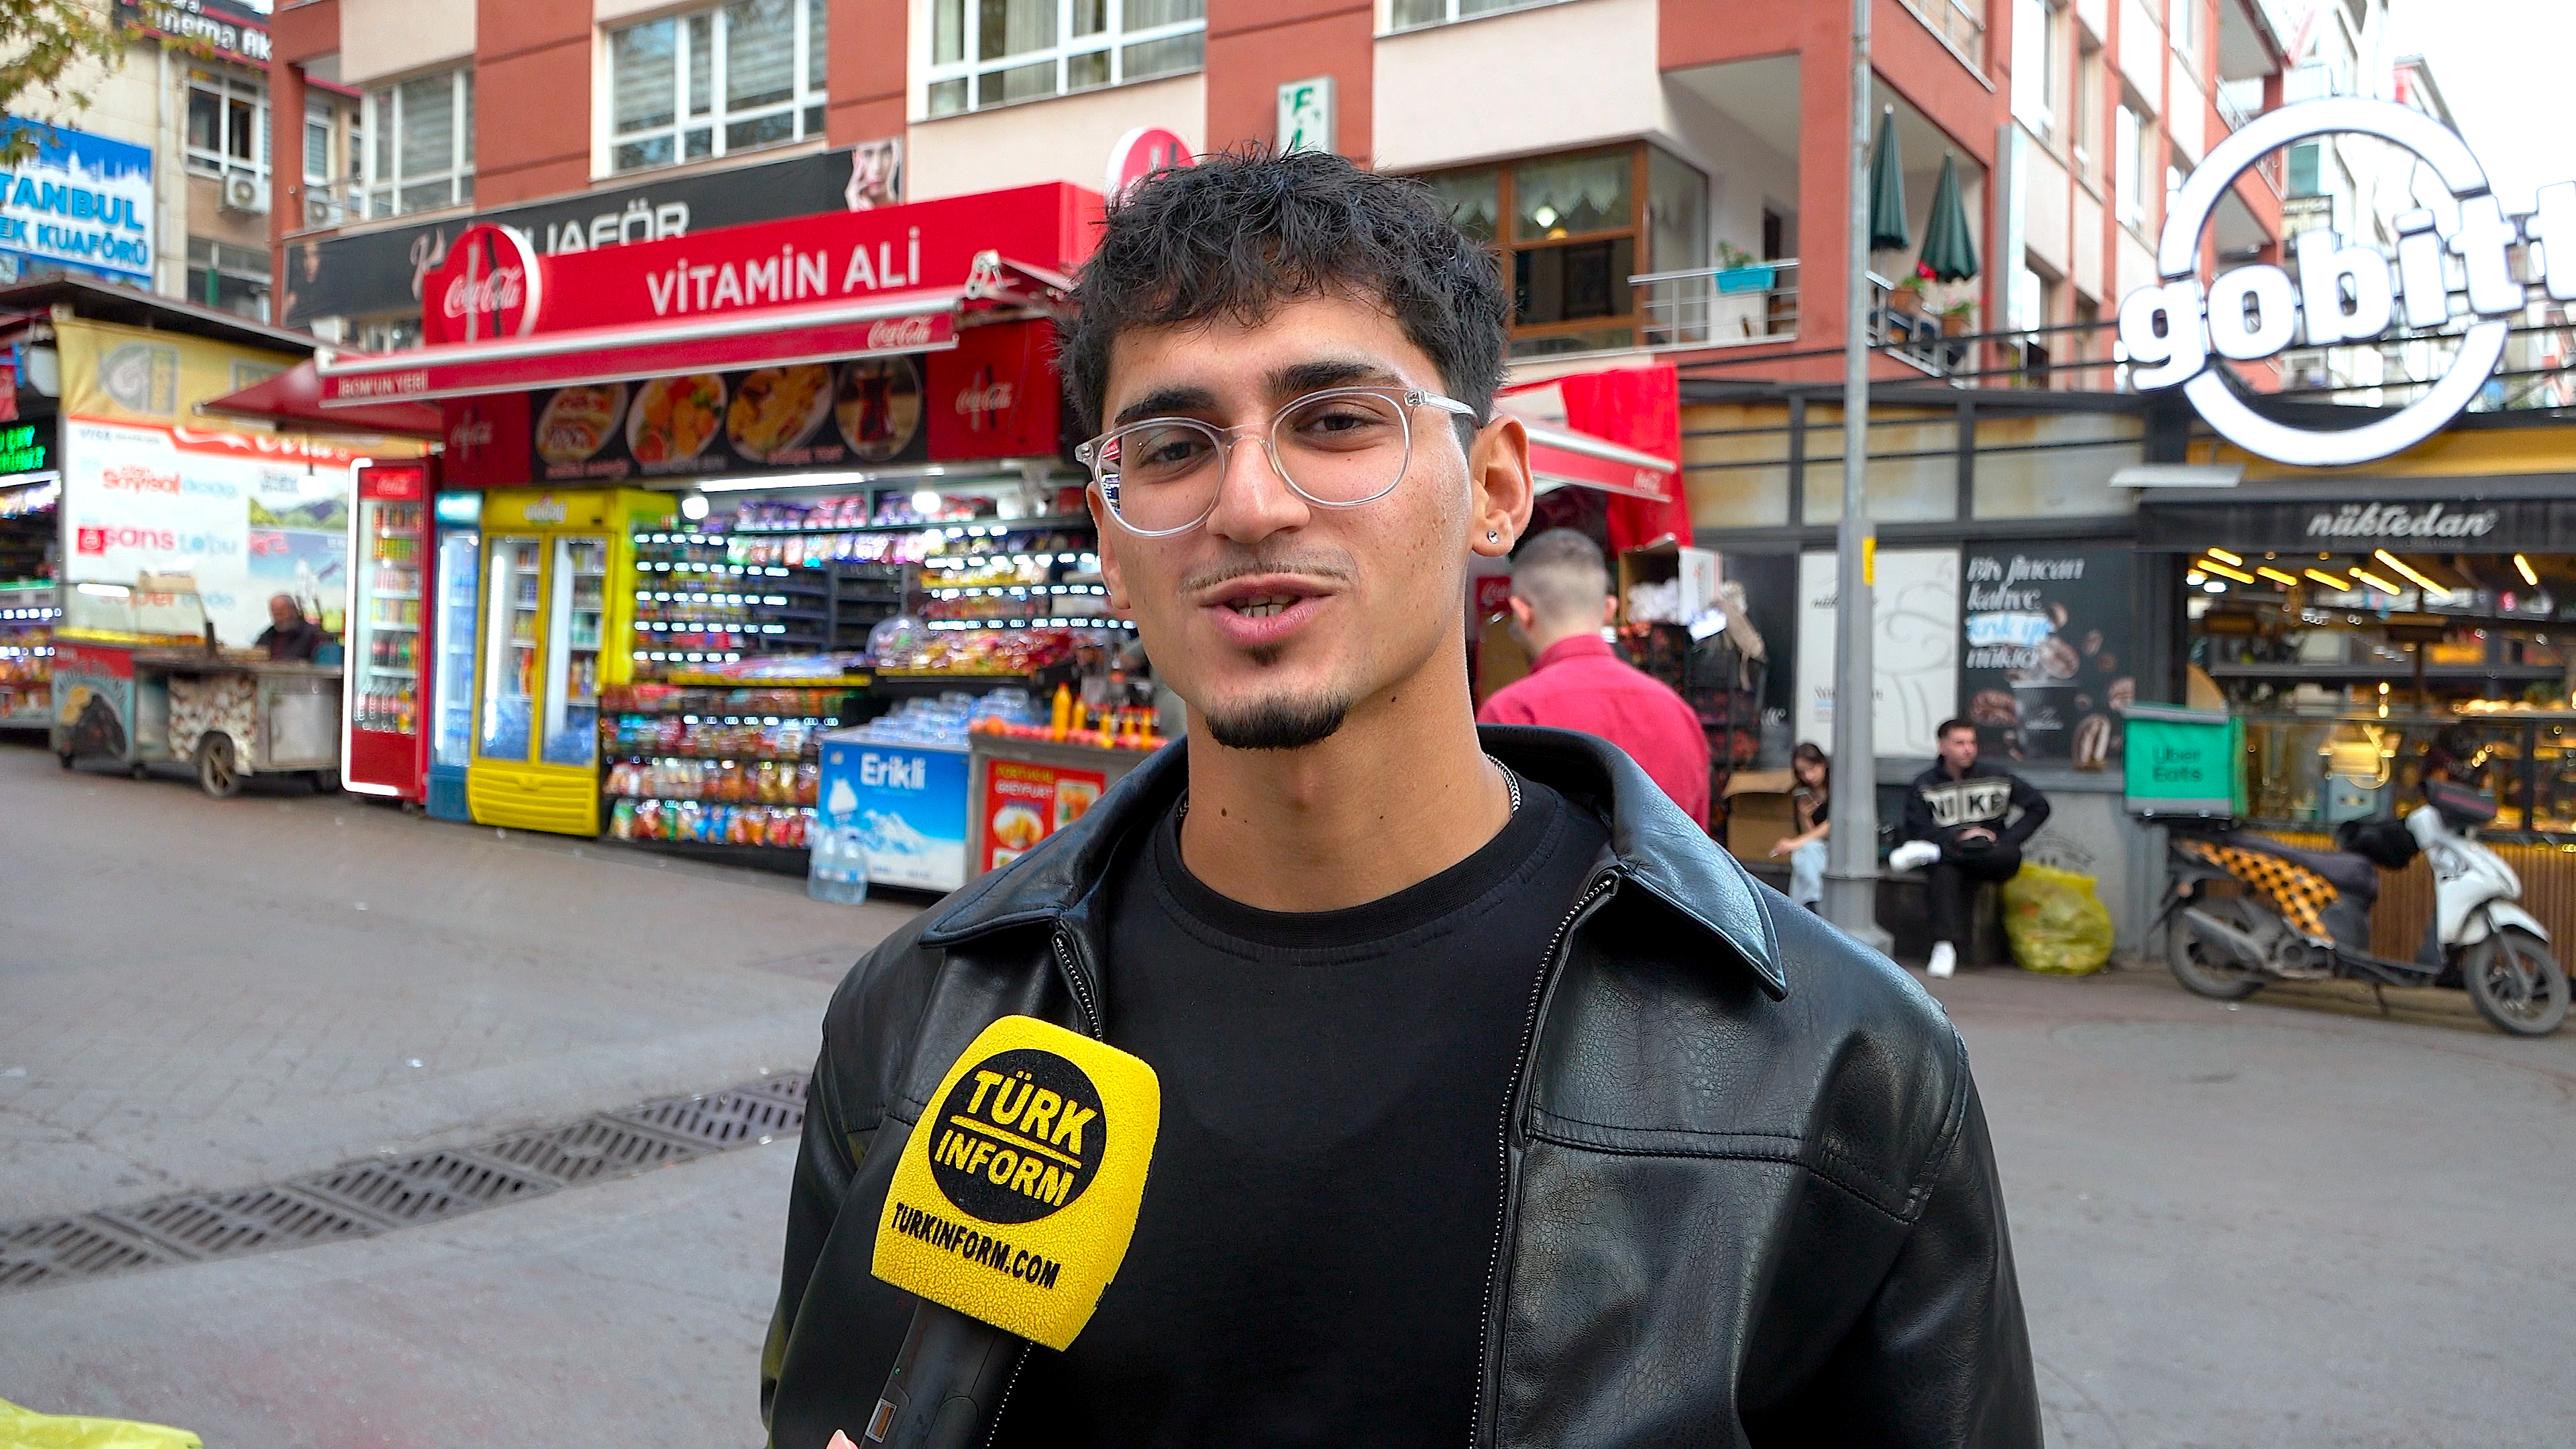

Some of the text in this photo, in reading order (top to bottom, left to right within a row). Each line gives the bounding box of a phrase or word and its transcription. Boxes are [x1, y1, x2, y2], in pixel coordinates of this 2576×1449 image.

[38, 223, 147, 265] KUAFÖRÜ
[646, 227, 920, 316] VİTAMİN ALİ
[2305, 502, 2497, 537] nüktedan
[861, 752, 926, 790] Erikli
[2152, 745, 2202, 763] Uber
[2152, 765, 2202, 784] Eats
[973, 1069, 1098, 1155] TÜRK
[934, 1130, 1076, 1208] INFORM
[890, 1202, 1061, 1290] TURKINFORM.COM
